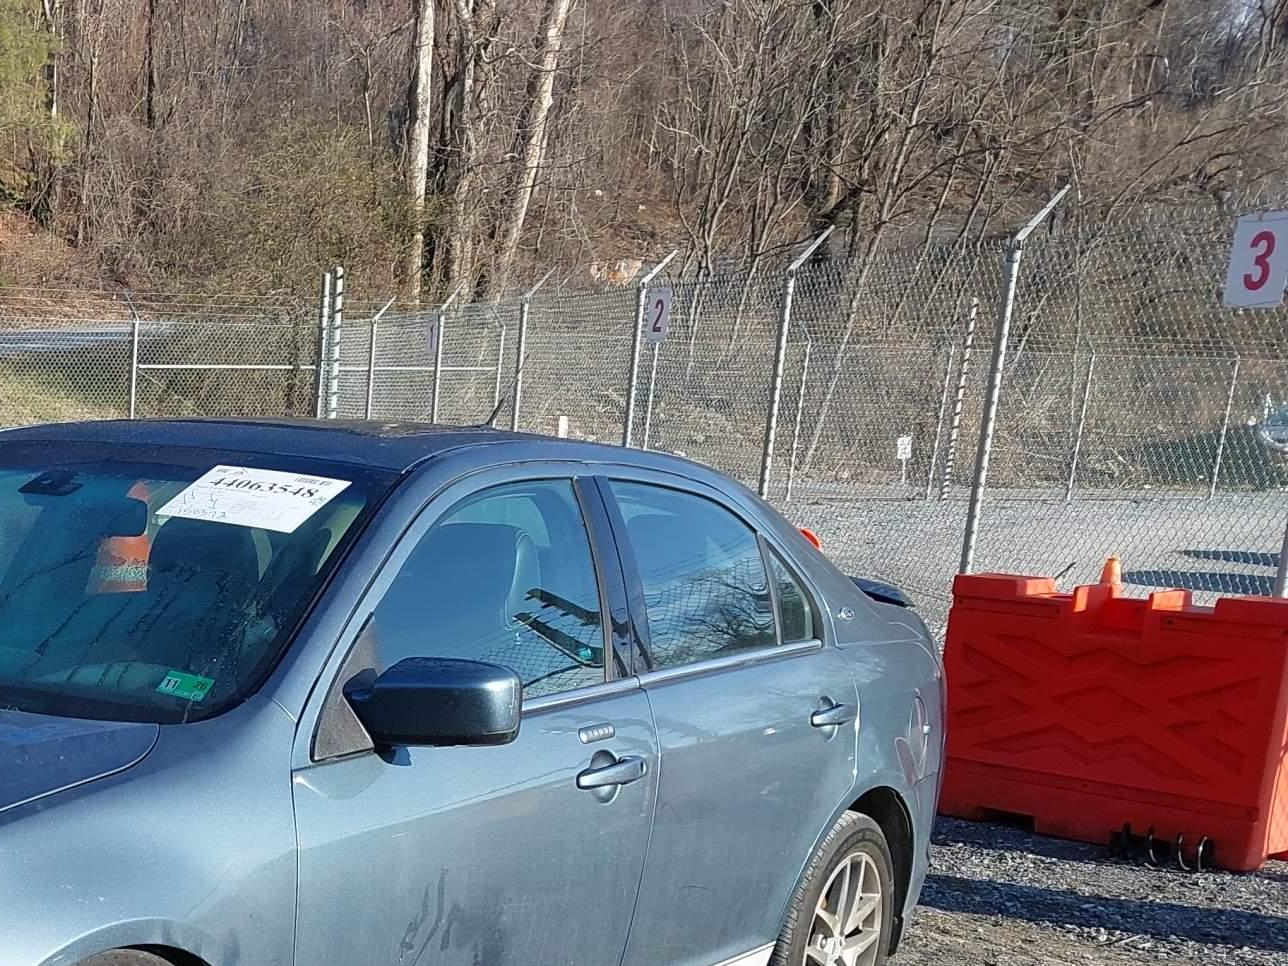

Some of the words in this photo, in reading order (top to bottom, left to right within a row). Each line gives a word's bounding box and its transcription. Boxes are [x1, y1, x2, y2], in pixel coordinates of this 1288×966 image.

[1243, 230, 1276, 291] 3
[652, 298, 664, 333] 2
[210, 477, 319, 498] 44063548
[164, 679, 179, 689] 11
